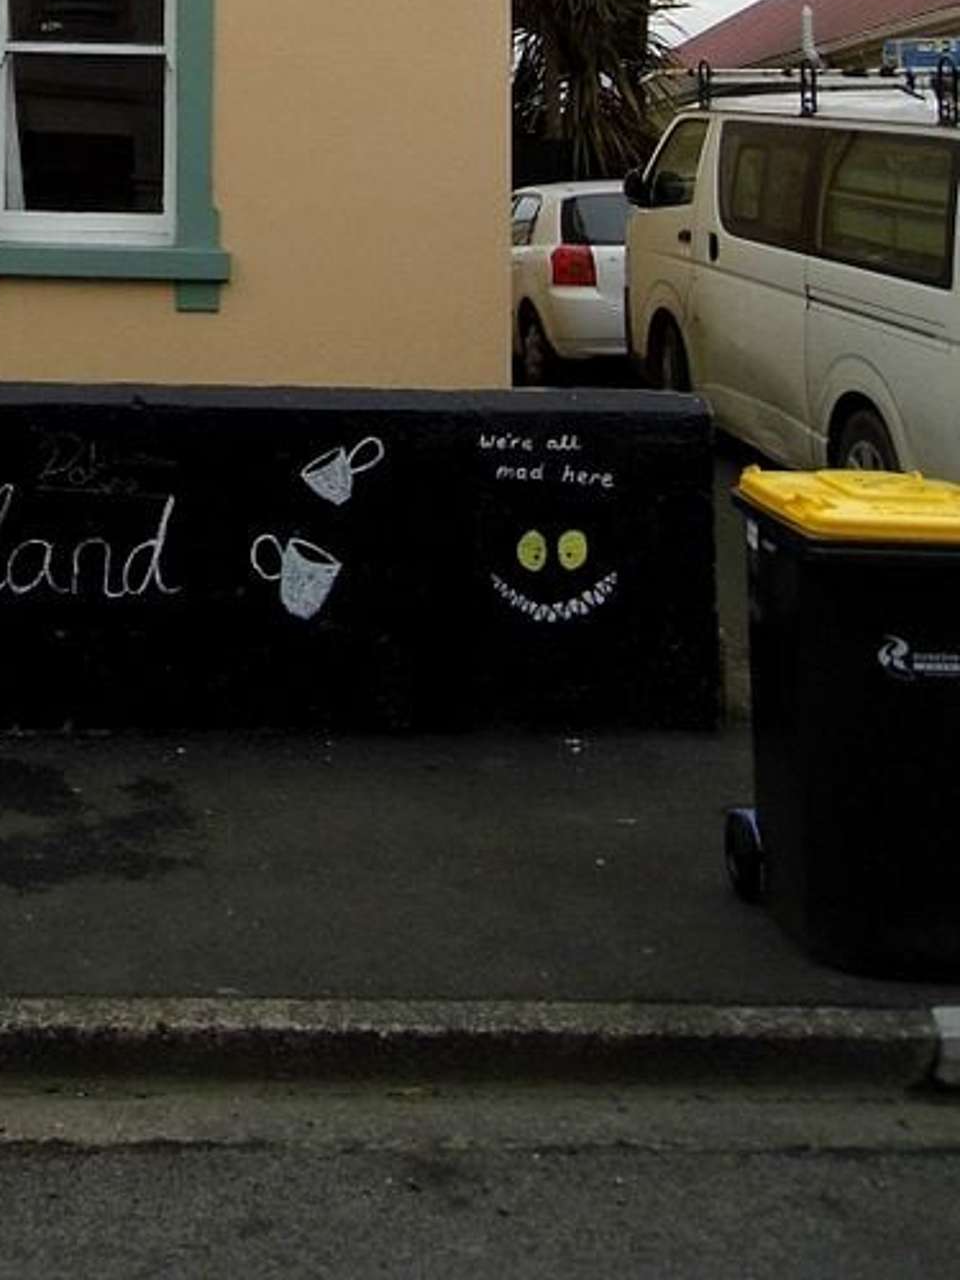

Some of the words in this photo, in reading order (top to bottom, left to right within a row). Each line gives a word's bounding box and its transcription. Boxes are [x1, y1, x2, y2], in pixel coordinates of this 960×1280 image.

[479, 433, 534, 451] We're
[546, 434, 583, 451] all
[495, 463, 545, 481] mad
[561, 464, 614, 489] here
